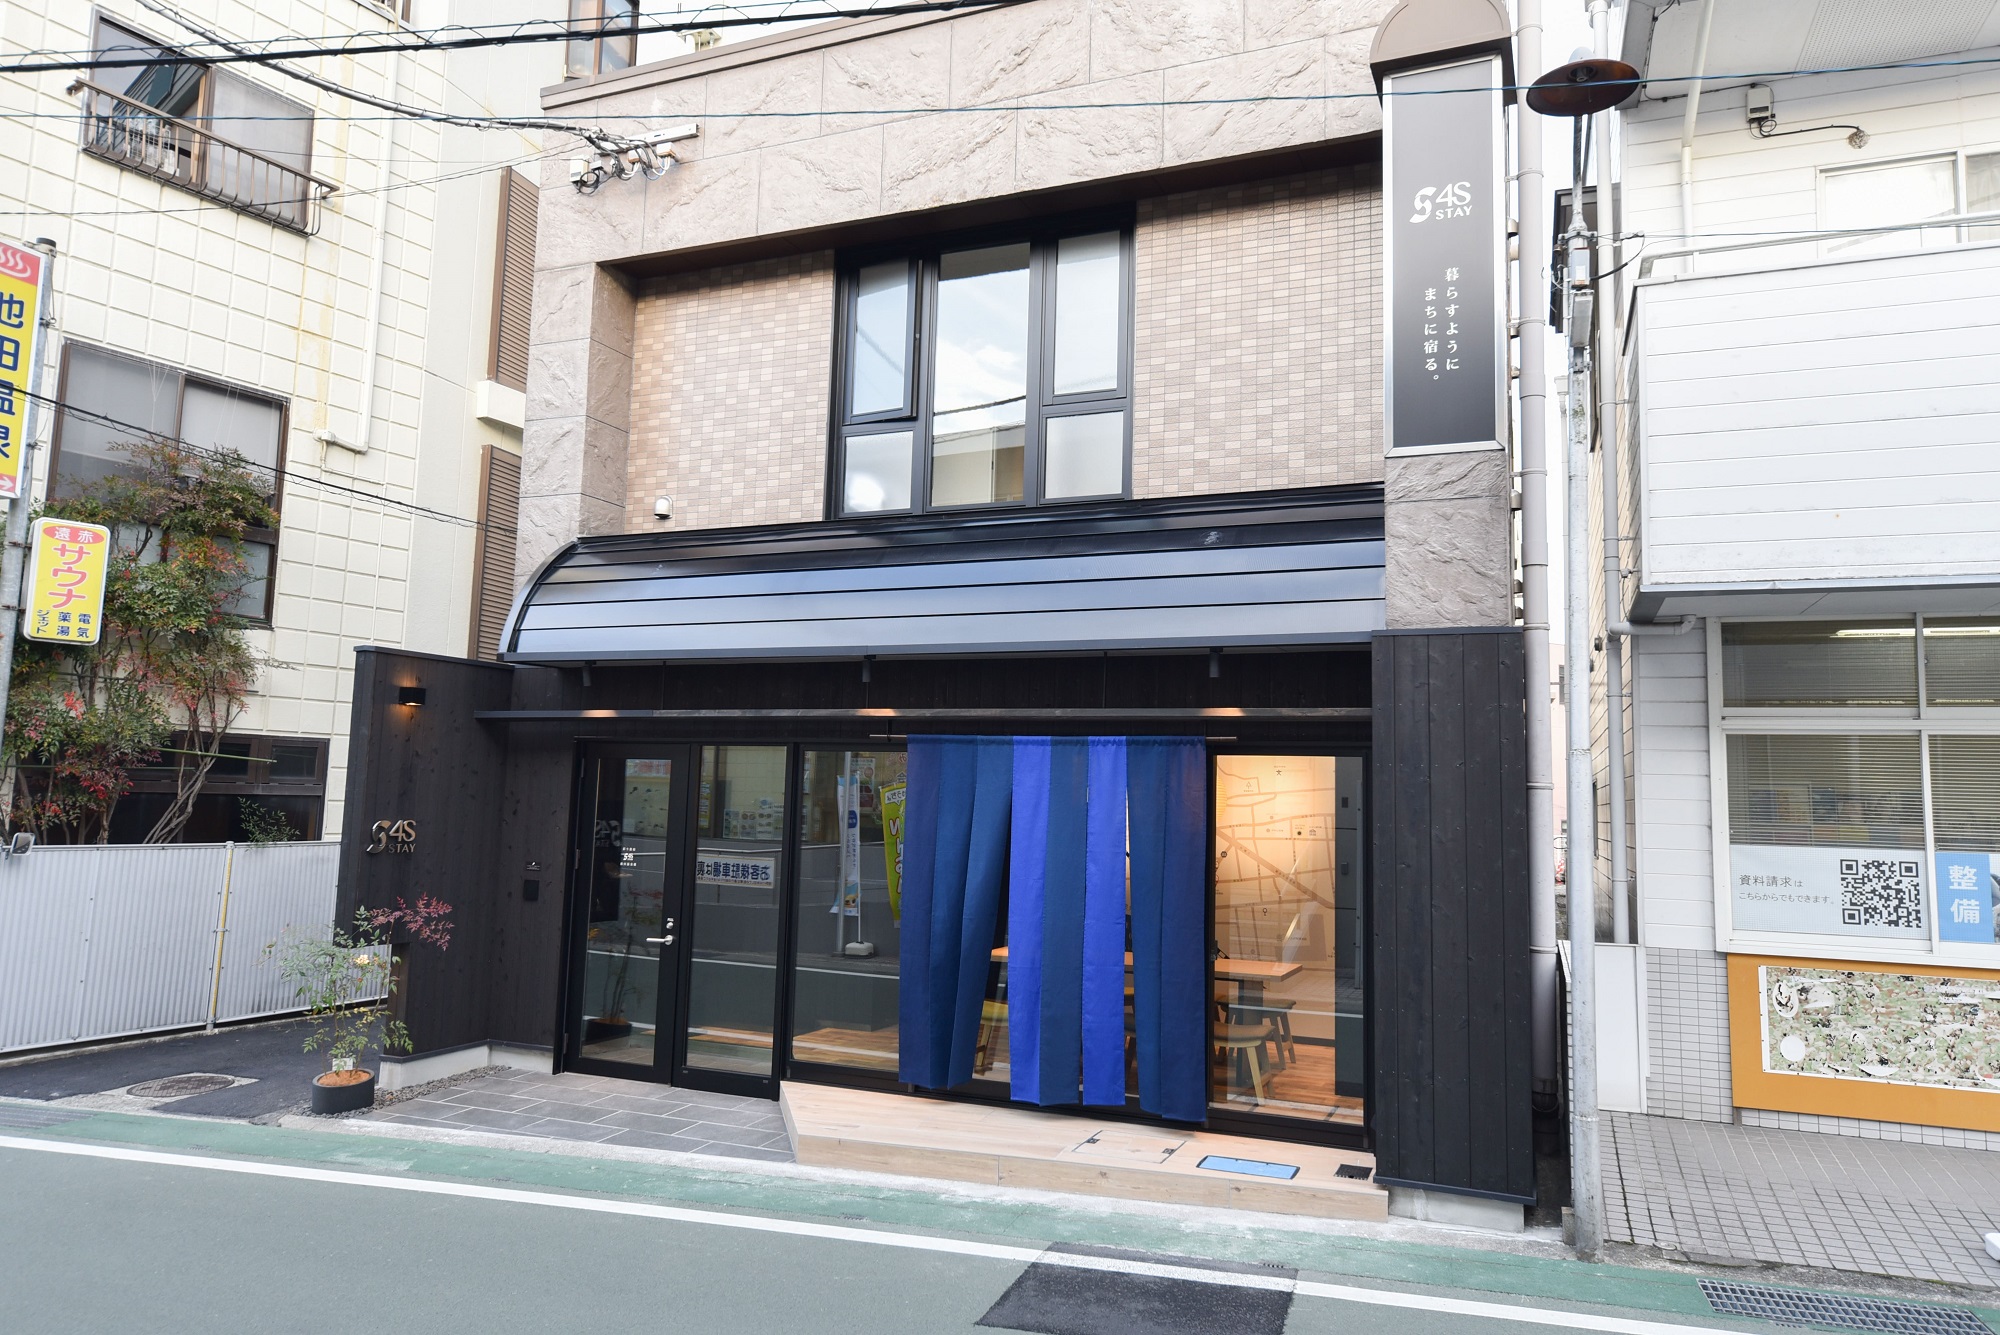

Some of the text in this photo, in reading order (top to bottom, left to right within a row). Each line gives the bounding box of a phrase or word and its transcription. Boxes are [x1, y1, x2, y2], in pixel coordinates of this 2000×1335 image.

[1435, 205, 1473, 220] STAY
[1444, 267, 1460, 371] 暮らすように
[1423, 287, 1439, 380] まちに宿る。
[48, 543, 91, 609] サウナ
[57, 612, 72, 637] 薬湯
[77, 613, 92, 638] 電気
[389, 844, 416, 853] STAY
[1739, 892, 1834, 905] こちらからでもできます。
[1948, 865, 1980, 923] 整備
